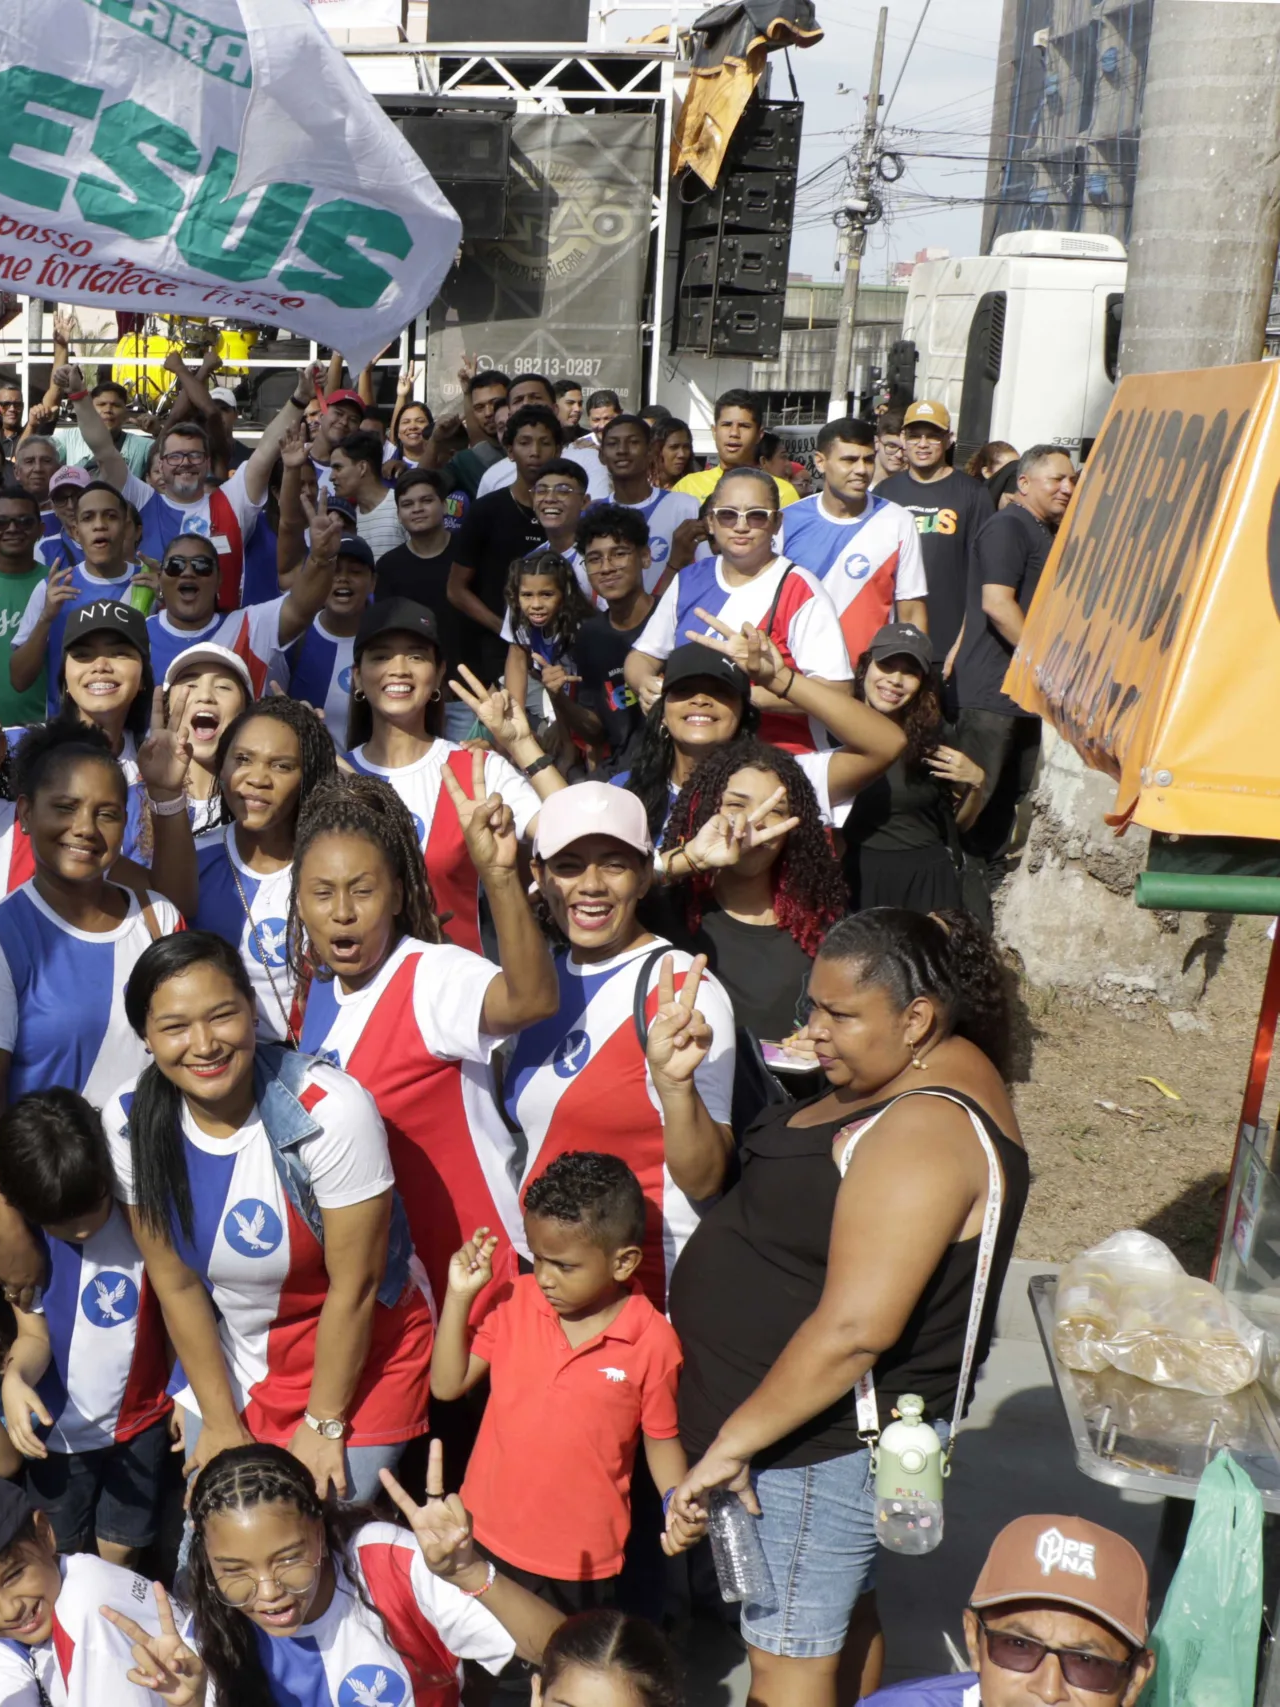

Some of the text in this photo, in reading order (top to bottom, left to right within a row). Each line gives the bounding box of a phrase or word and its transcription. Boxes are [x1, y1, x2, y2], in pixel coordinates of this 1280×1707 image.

[94, 0, 252, 84] ARA
[36, 253, 178, 297] fortalece.
[514, 357, 602, 377] 98213-0287
[1051, 436, 1082, 446] 330
[80, 602, 129, 623] NYC
[608, 667, 625, 678] MARC
[1063, 1537, 1097, 1561] PE
[1060, 1553, 1097, 1579] NA
[131, 1573, 148, 1604] IGREJ
